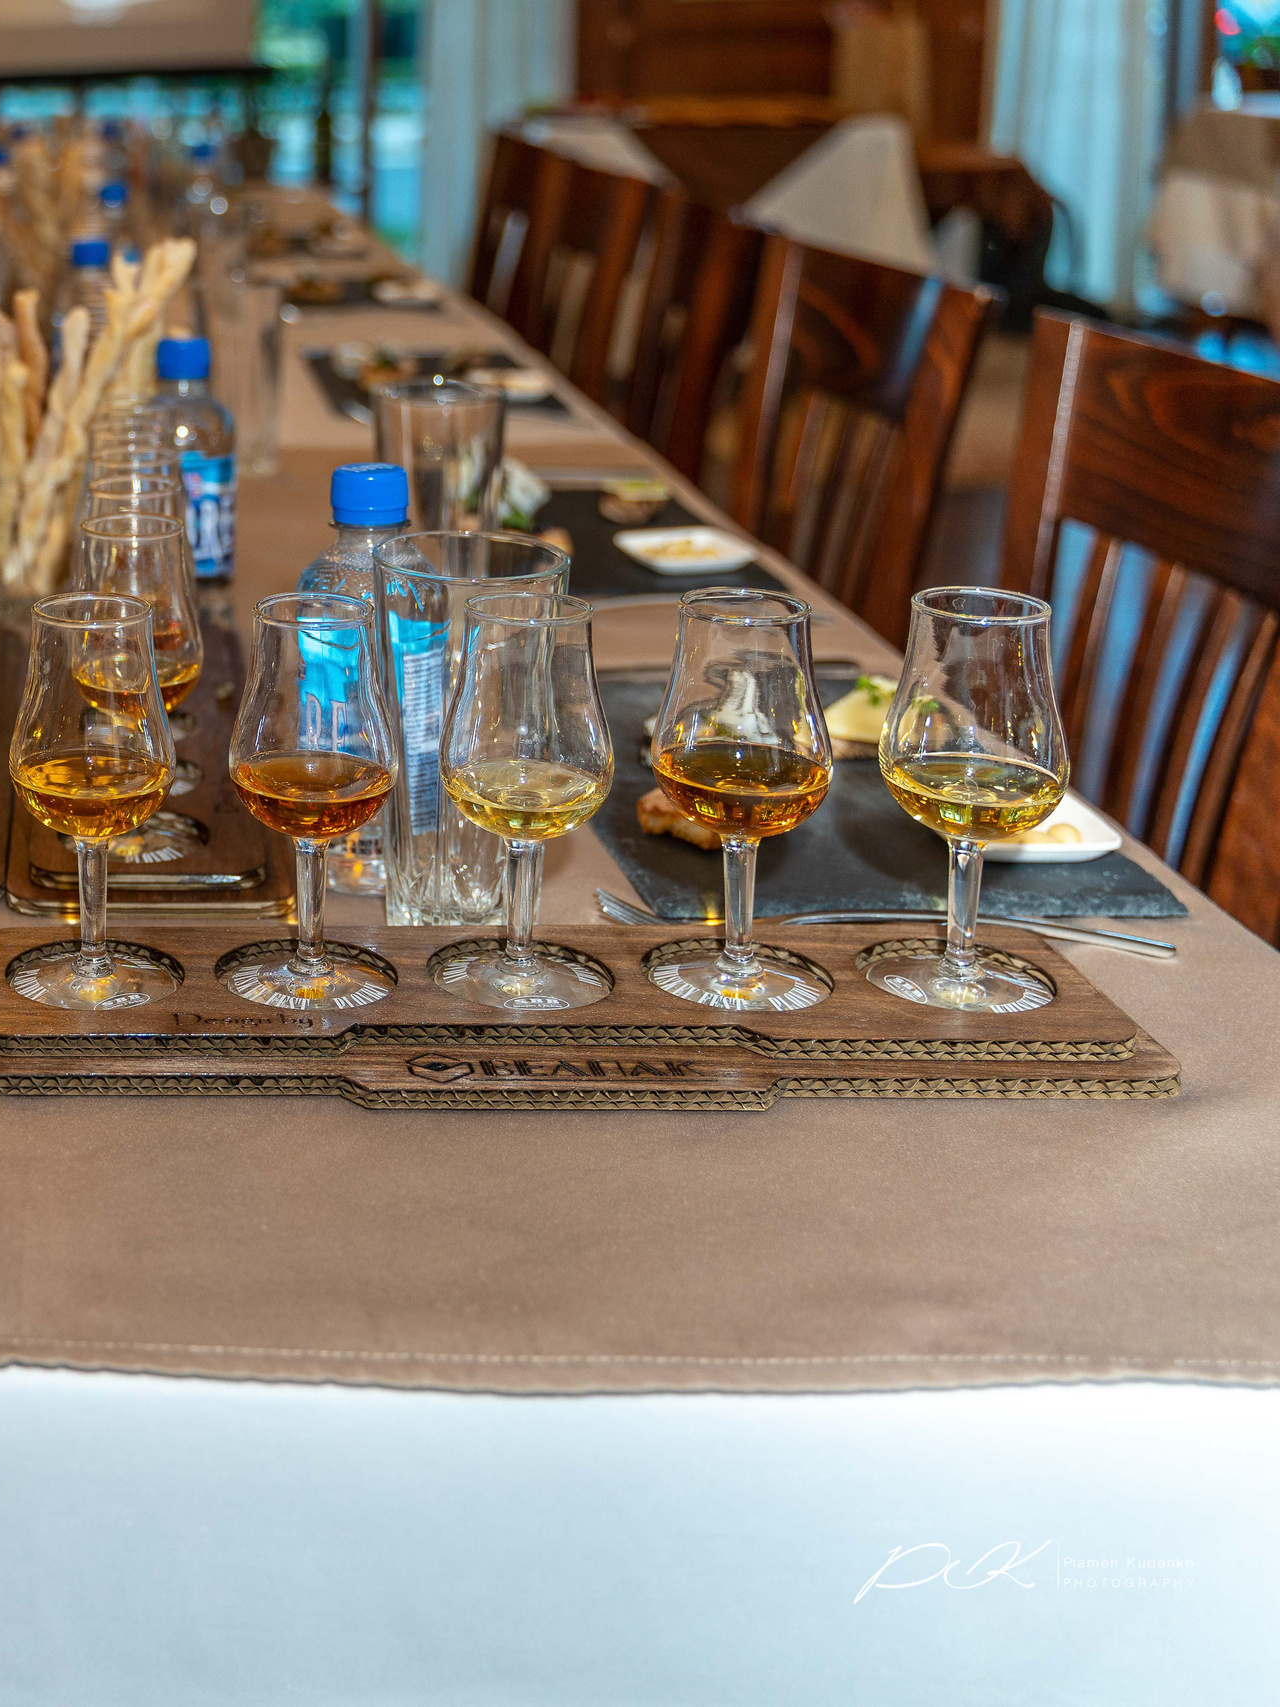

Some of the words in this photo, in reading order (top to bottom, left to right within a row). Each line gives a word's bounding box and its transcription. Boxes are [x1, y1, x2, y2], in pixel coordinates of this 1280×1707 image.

[265, 991, 310, 1011] FEST
[698, 991, 745, 1011] FEST
[172, 1012, 272, 1028] Design
[279, 1013, 314, 1029] by
